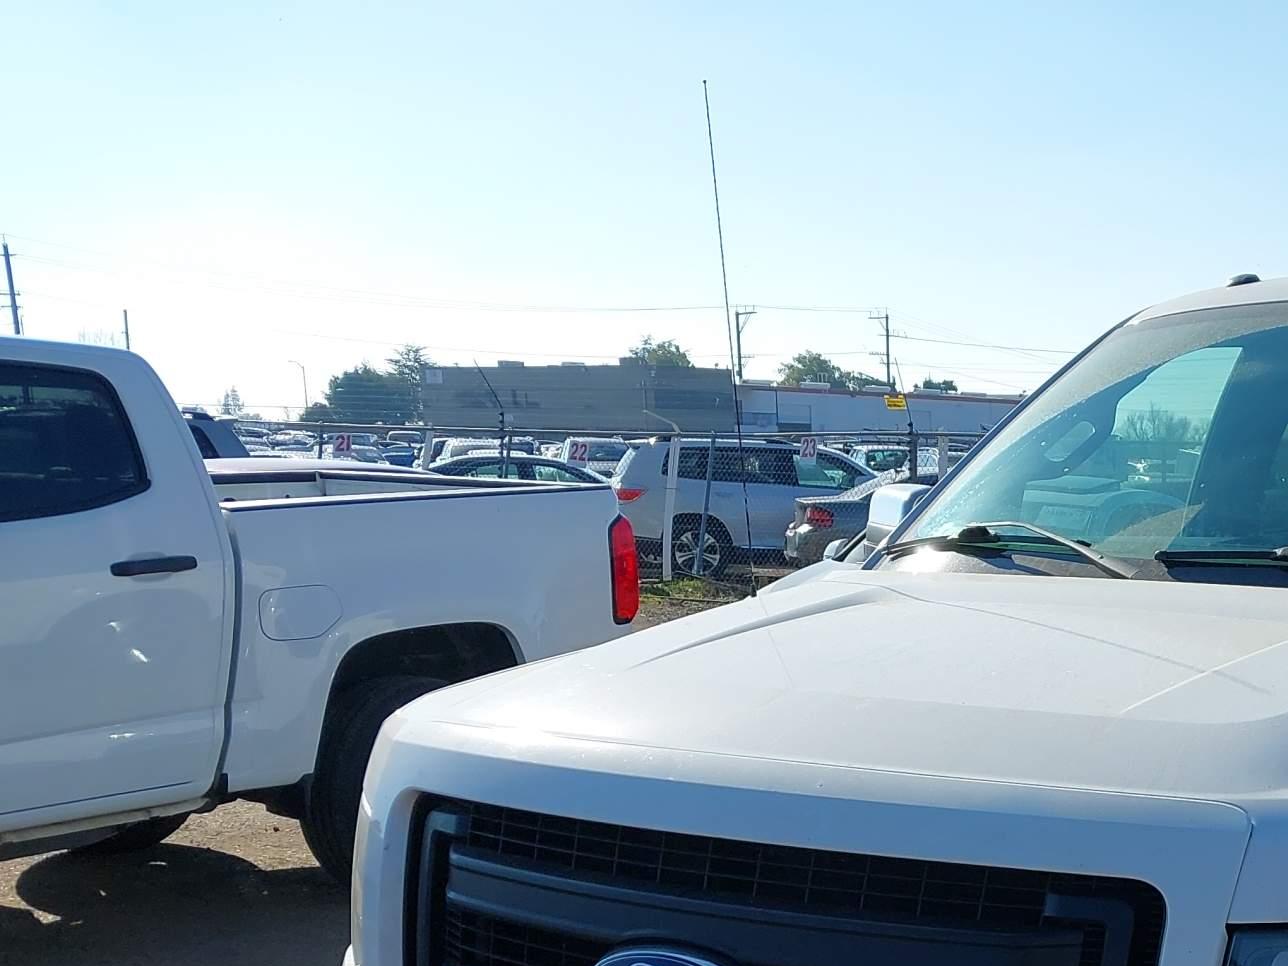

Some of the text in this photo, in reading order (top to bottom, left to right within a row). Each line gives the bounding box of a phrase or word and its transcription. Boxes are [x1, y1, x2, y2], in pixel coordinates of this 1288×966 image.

[335, 434, 351, 452] 21
[571, 442, 587, 462] 22
[801, 438, 816, 458] 23
